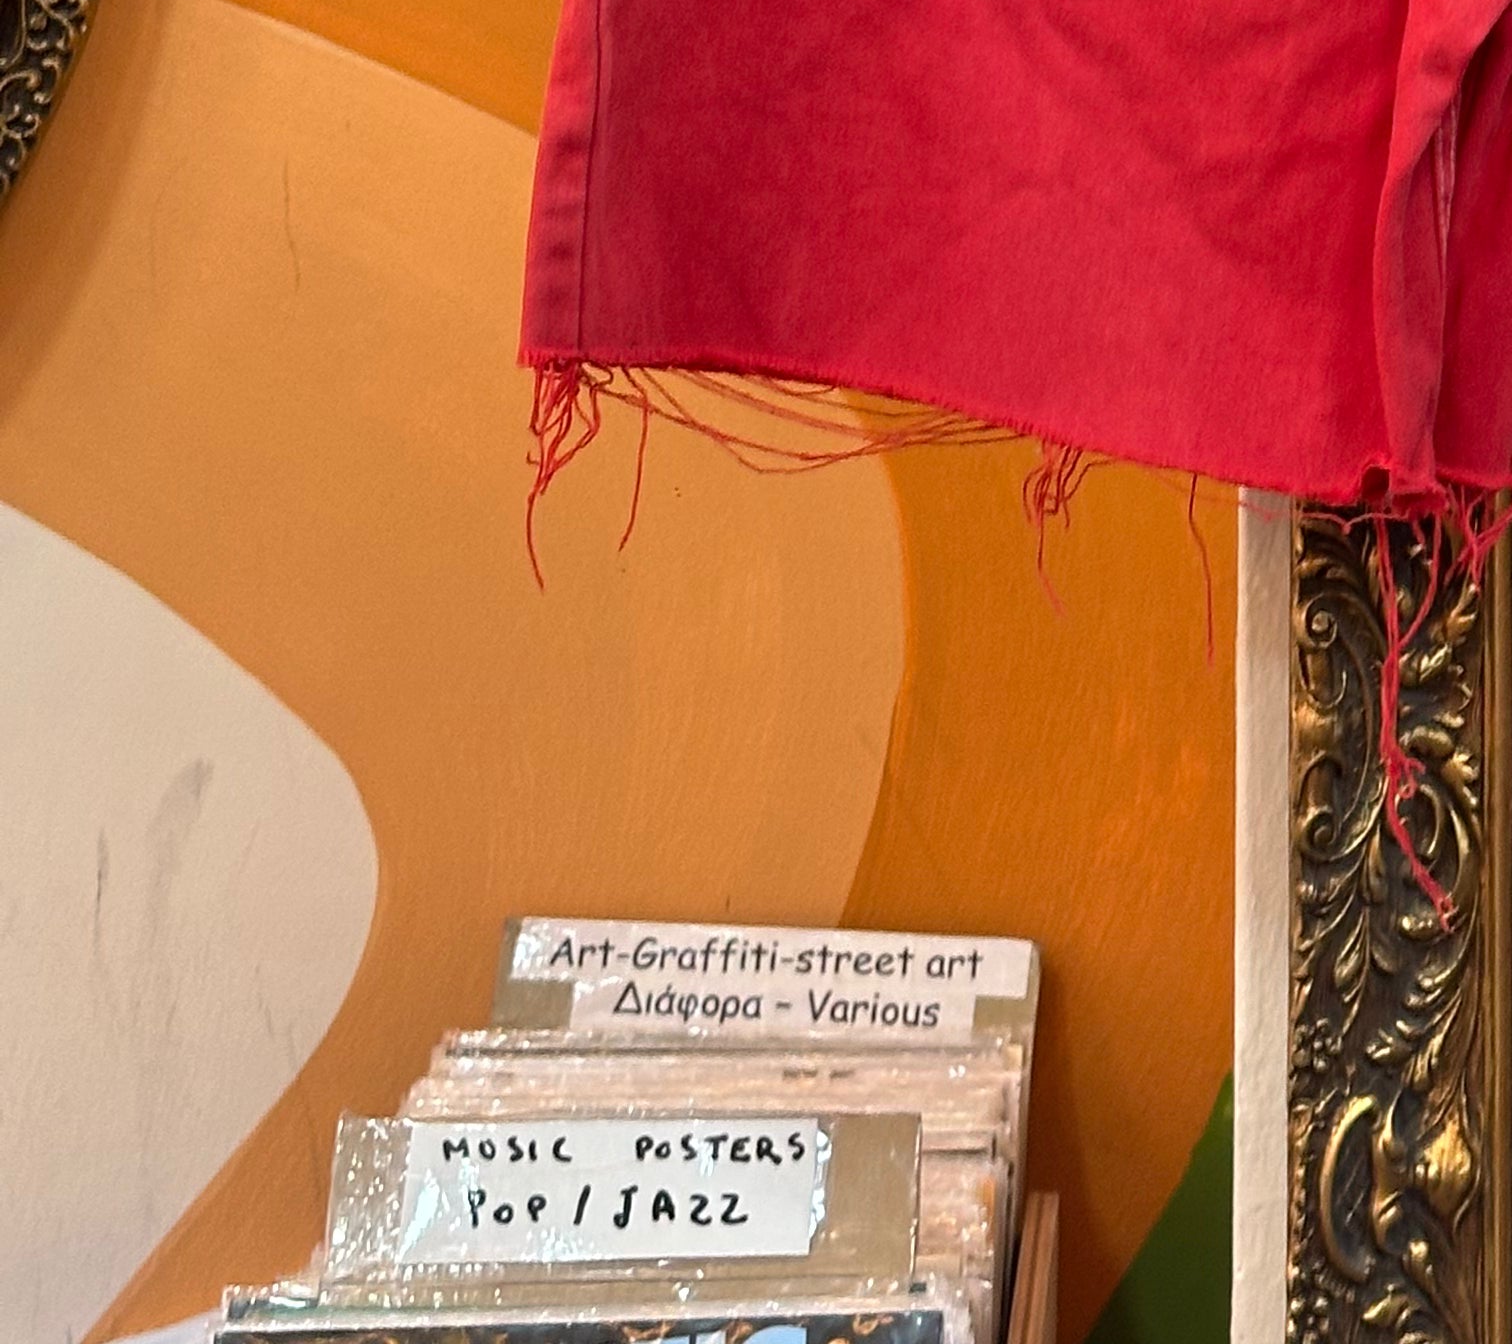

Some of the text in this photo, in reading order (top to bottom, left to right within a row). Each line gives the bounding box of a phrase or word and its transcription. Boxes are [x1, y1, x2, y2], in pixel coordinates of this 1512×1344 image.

[550, 936, 984, 981] Art-Graffiti-street art
[613, 980, 763, 1026] Διάφορα
[808, 988, 942, 1028] Various
[612, 1185, 749, 1230] JAZZ
